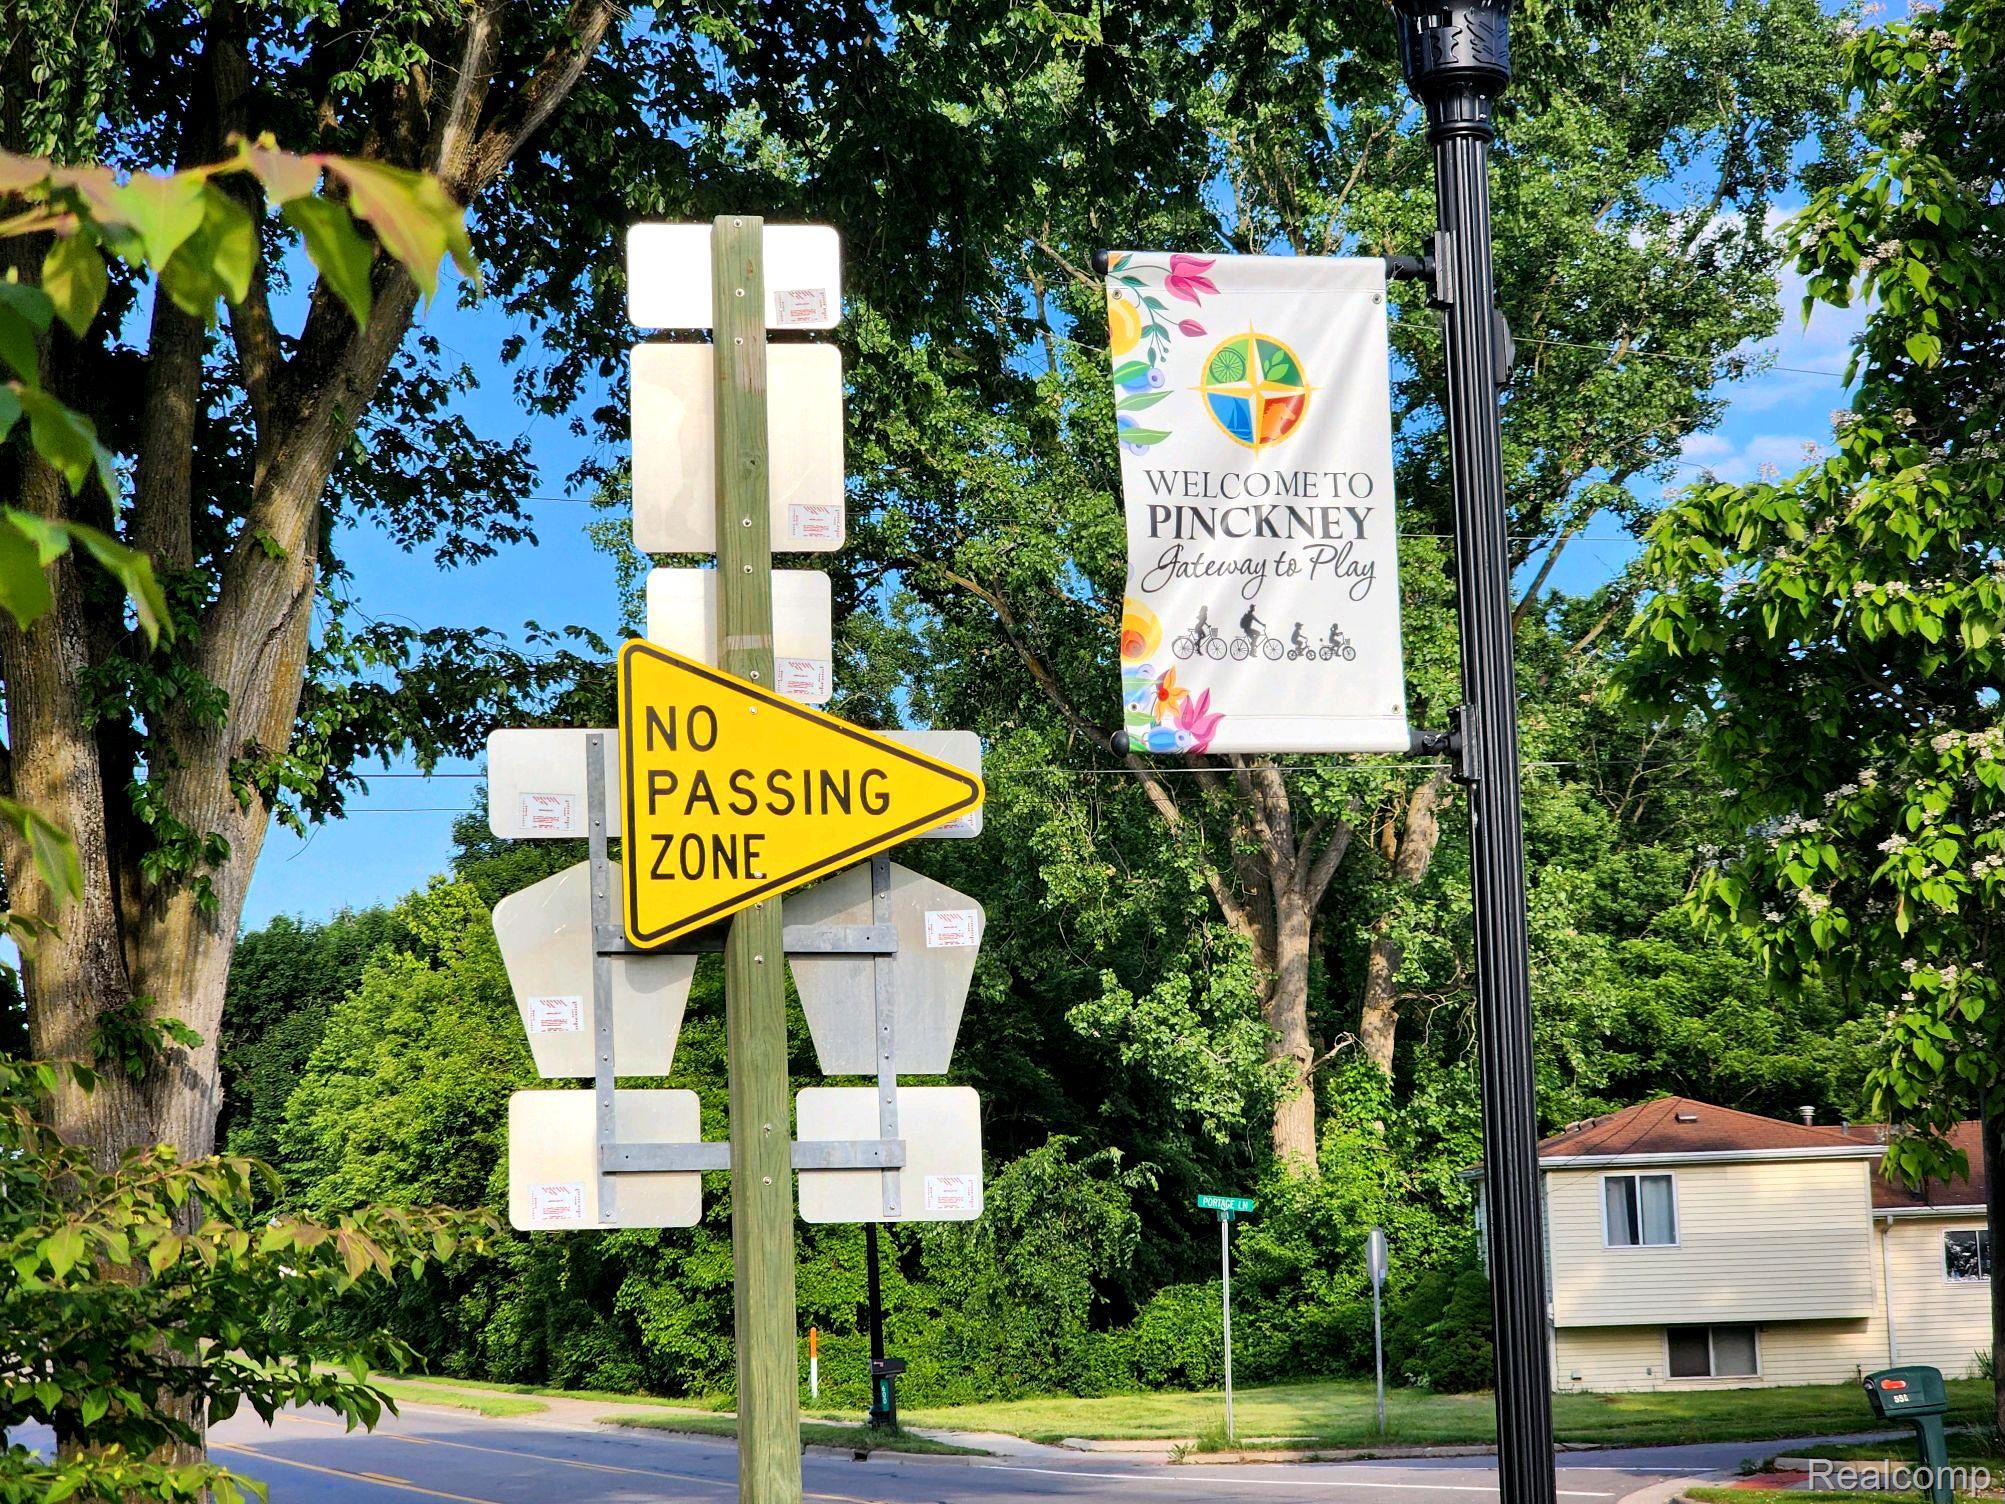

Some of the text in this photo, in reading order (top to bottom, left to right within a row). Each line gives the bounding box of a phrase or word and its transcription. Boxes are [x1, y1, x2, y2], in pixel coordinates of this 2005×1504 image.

[1142, 470, 1374, 499] WELCOME TO
[1146, 504, 1376, 540] PINCKNEY
[1141, 541, 1376, 602] Gateway to Play
[645, 704, 718, 752] NO
[647, 768, 891, 816] PASSING
[650, 833, 767, 880] ZONE
[1203, 1197, 1248, 1210] PORTAGE LN
